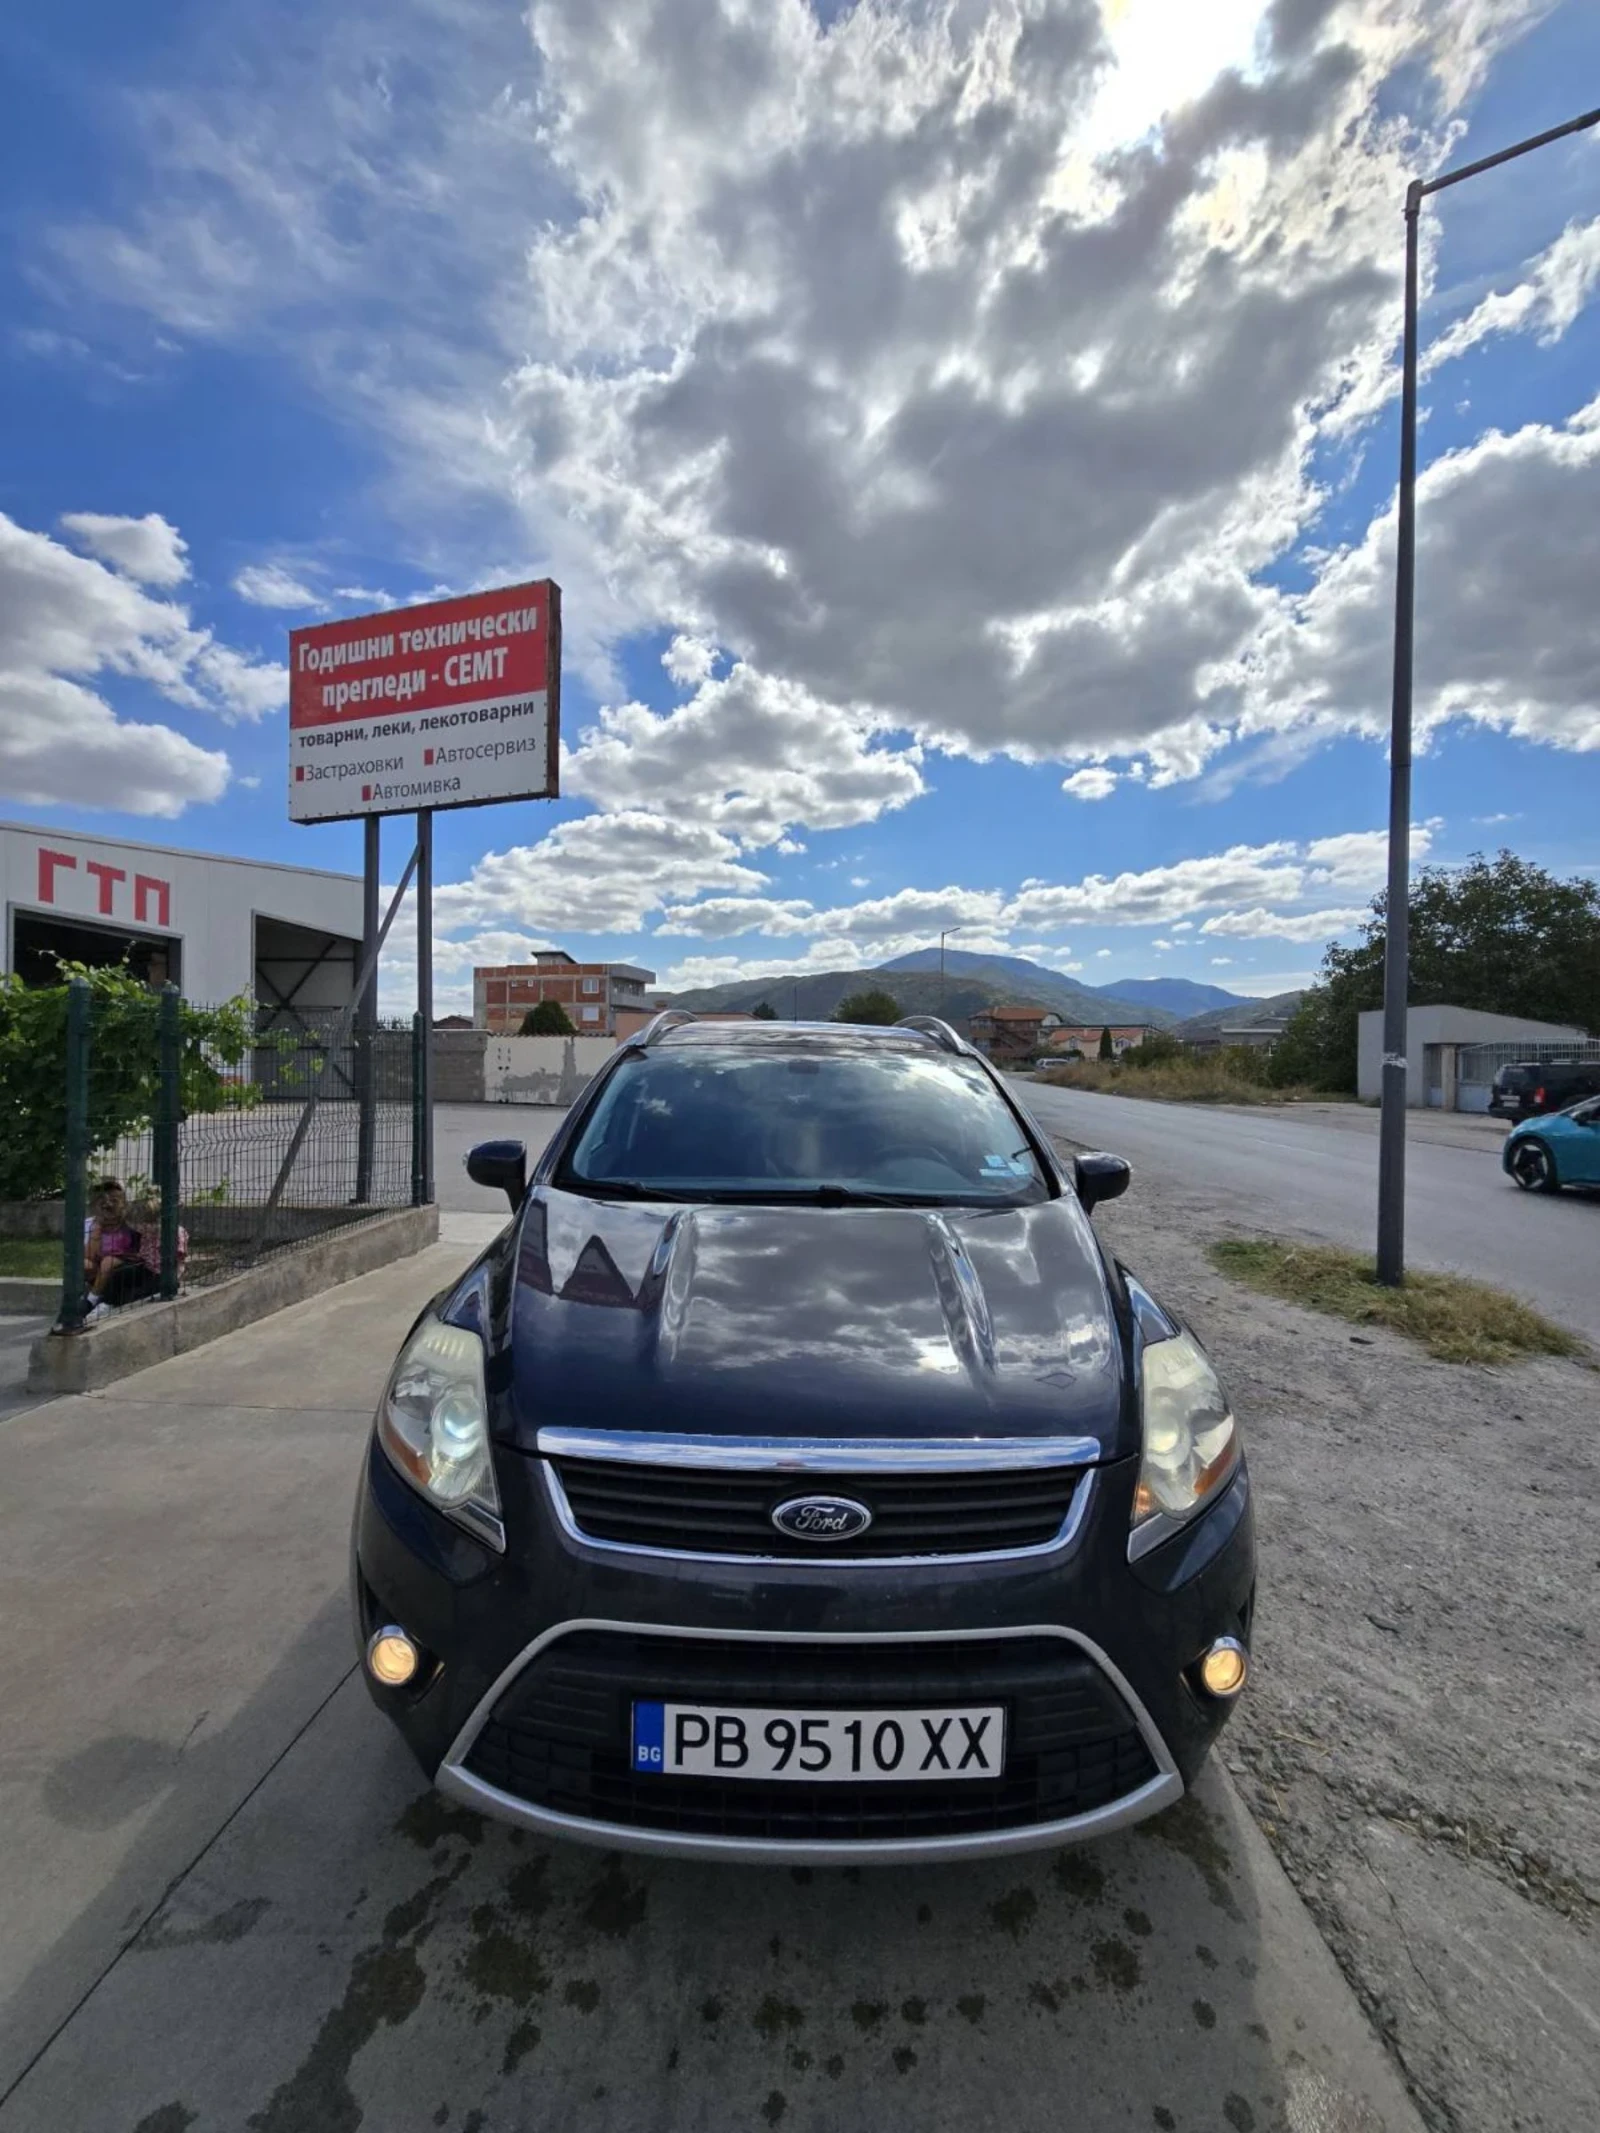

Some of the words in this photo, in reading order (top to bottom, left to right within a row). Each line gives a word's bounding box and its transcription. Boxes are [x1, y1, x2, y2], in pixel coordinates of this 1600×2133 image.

[298, 632, 394, 674] Годишни
[399, 607, 537, 654] технически
[322, 669, 425, 712] прегледи
[444, 647, 508, 687] СЕМТ
[299, 728, 369, 748] товарни,
[372, 721, 415, 738] леки,
[419, 701, 534, 731] лекотоварни
[305, 755, 404, 782] Застраховки
[435, 737, 536, 765] Автосервиз
[373, 776, 461, 800] Автомивка
[38, 848, 171, 927] ГТП
[795, 1506, 848, 1530] Ford
[637, 1746, 662, 1762] BG
[674, 1713, 749, 1768] PB
[764, 1718, 905, 1772] 9510
[920, 1716, 993, 1771] XX
